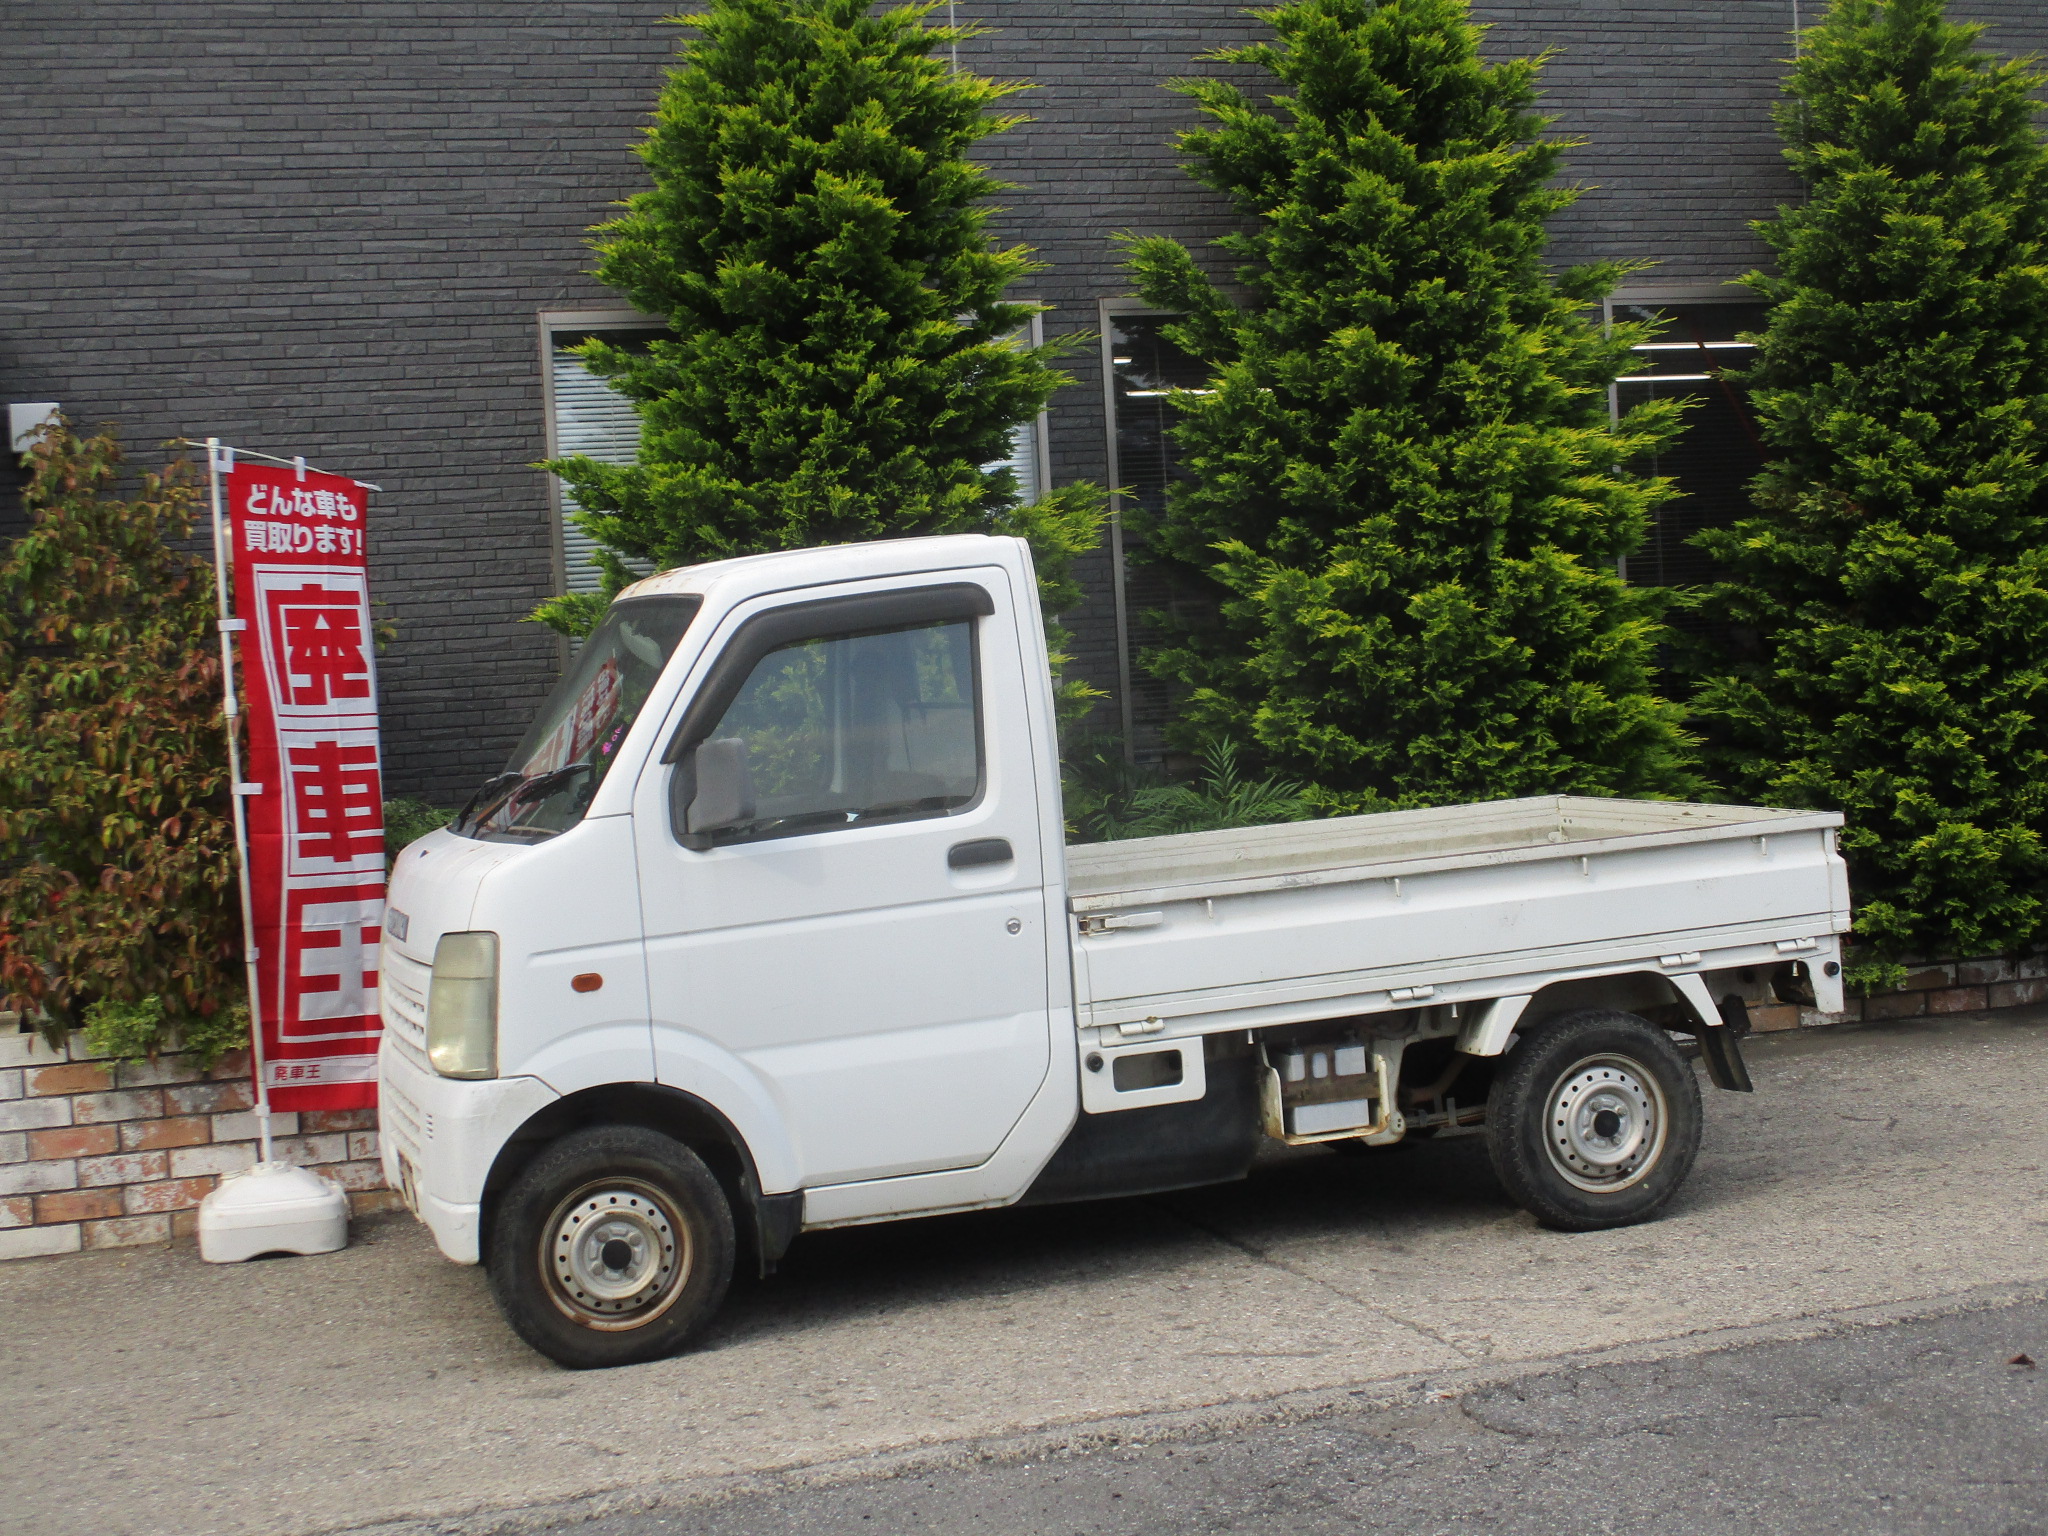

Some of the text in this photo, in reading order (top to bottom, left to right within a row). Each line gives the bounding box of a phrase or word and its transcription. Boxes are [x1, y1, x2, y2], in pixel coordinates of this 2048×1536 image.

[246, 483, 358, 521] どんな車も
[243, 520, 363, 556] 買取ります!
[265, 582, 384, 1021] 廃車王
[273, 1063, 321, 1081] 廃車王
